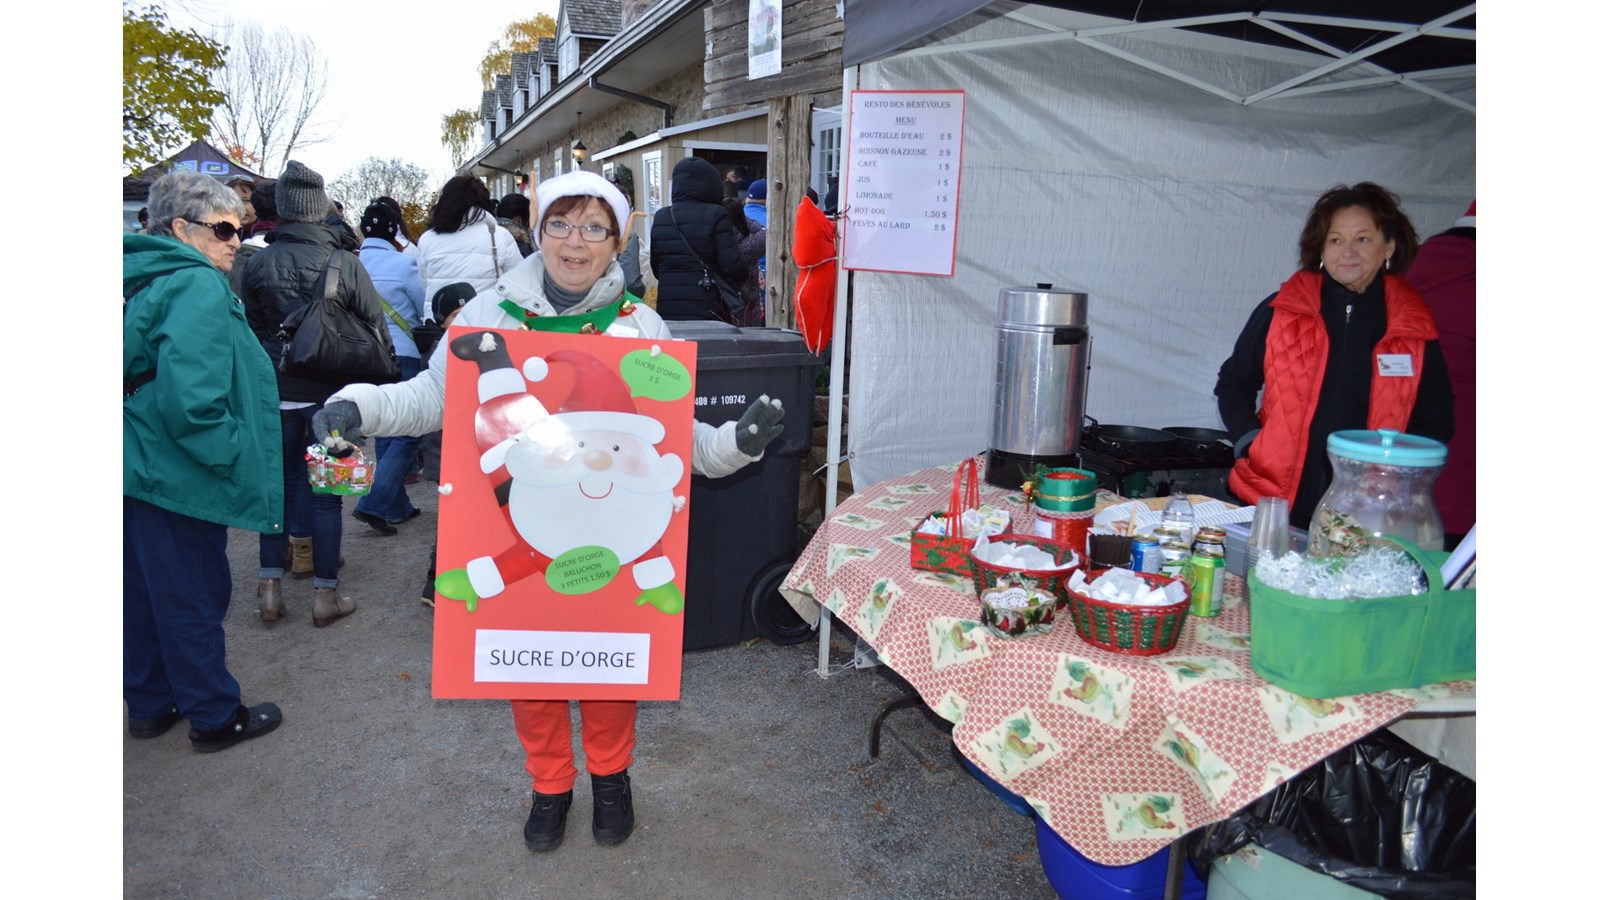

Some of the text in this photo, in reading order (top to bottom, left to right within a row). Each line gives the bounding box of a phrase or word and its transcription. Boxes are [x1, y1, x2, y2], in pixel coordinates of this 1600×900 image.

[864, 100, 889, 109] RESTO
[890, 101, 905, 109] DES
[895, 116, 917, 125] MENU
[859, 131, 924, 140] BOUTEILLE D'EAU
[947, 133, 952, 141] $
[858, 147, 927, 156] BOISSON GAZEUSE
[946, 149, 951, 157] $
[858, 159, 878, 168] CAFÉ
[945, 163, 950, 171] $
[856, 191, 893, 200] LIMONADE
[854, 206, 886, 215] HOT-DOG
[924, 211, 948, 219] 1,50 $
[877, 221, 889, 229] AU
[889, 221, 911, 230] LARD
[940, 224, 946, 232] $
[633, 358, 682, 382] SUCRE D'ORGE
[721, 395, 746, 404] 109742
[554, 550, 605, 570] SUCRE D'ORGE
[563, 562, 602, 578] BALUCHON
[560, 582, 566, 590] 3
[566, 576, 590, 588] PETITS
[490, 649, 636, 669] SUCRE D'ORGE
